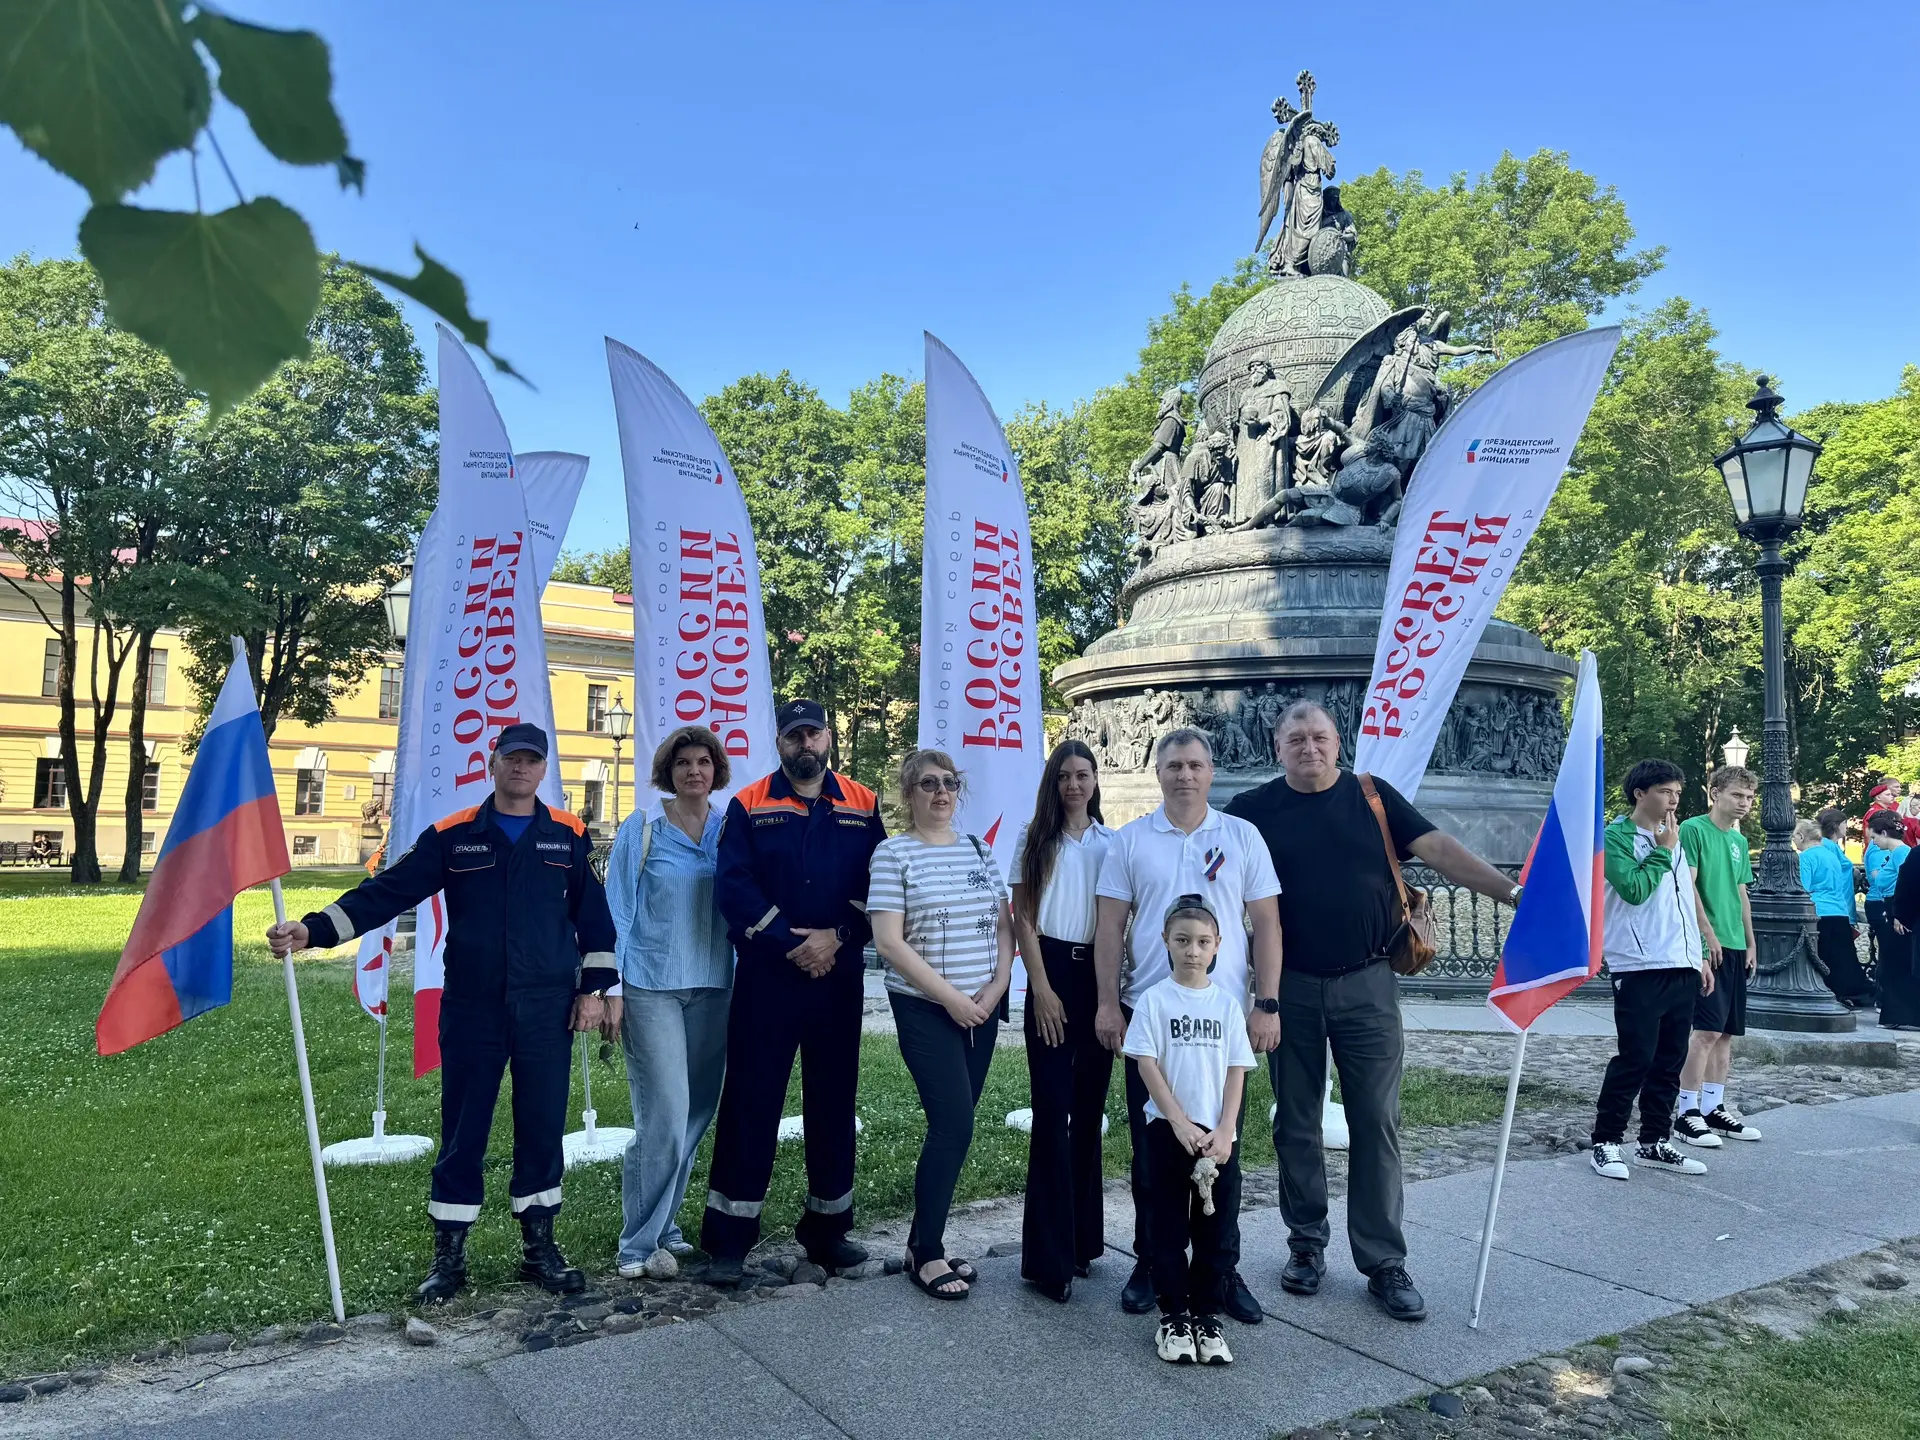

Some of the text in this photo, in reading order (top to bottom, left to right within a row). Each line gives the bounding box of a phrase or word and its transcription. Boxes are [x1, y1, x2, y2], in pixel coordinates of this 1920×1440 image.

[1484, 438, 1554, 447] ПРЕЗИДЕНТСКИЙ
[1481, 447, 1560, 456] ФОНД КУЛЬТУРНЫХ
[1478, 456, 1530, 464] ИНИЦИАТИВ
[1361, 510, 1468, 741] РАССВЕТ
[1383, 513, 1512, 738] РОССИИ
[455, 844, 489, 853] СПАСАТЕЛЬ
